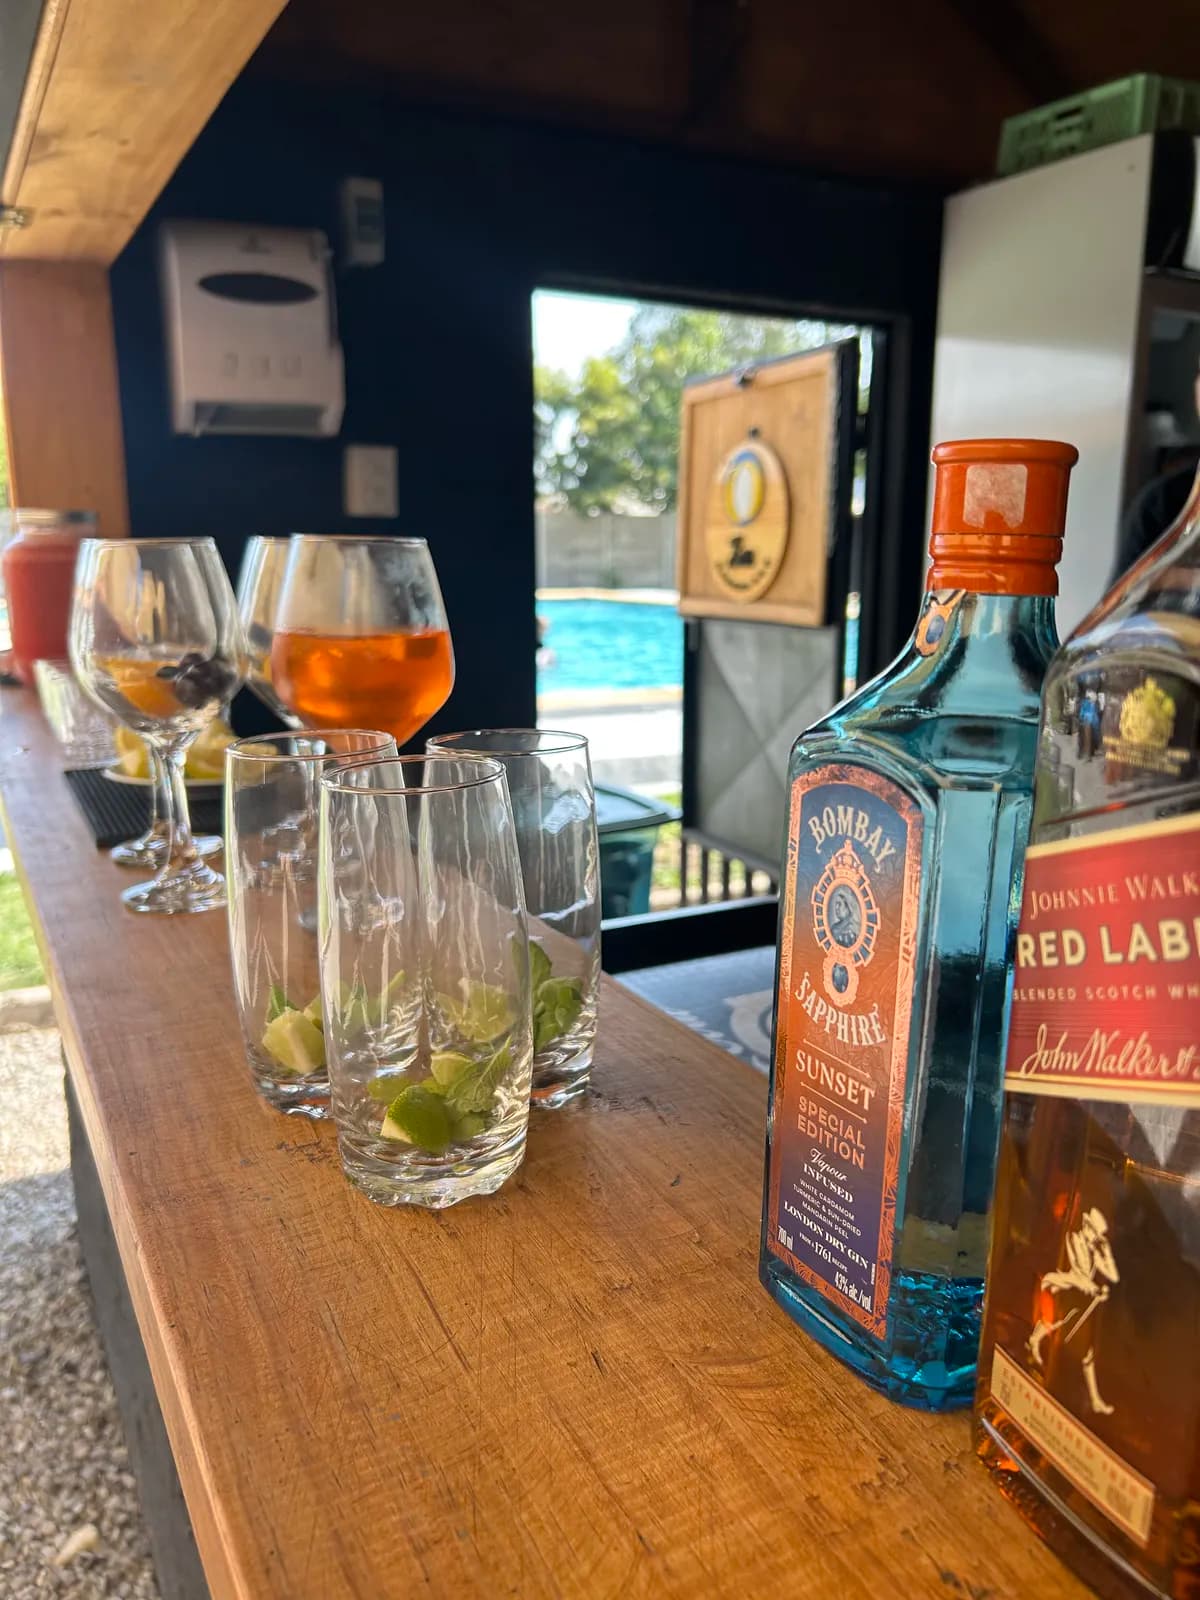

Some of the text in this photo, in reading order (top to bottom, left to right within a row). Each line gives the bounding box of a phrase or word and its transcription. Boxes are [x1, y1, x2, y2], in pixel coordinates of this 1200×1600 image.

[808, 805, 896, 873] BOMBAY
[1030, 882, 1119, 920] JOHNNIE
[1017, 917, 1200, 969] RED LAB
[795, 971, 887, 1046] SAPPHIRE
[1012, 986, 1077, 1001] BLENDED
[1085, 983, 1157, 1000] SCOTCH
[1020, 1023, 1082, 1078] John
[1080, 1027, 1174, 1078] Walker
[796, 1049, 876, 1111] SUNSET
[798, 1113, 865, 1170] EDITION
[799, 1096, 866, 1150] SPECIAL
[803, 1163, 854, 1203] INFUSED
[810, 1148, 848, 1181] Vapour
[793, 1183, 821, 1208] TURMERIC
[827, 1208, 862, 1237] SUN-DRIED
[800, 1178, 855, 1222] WHITE CARDAMOM
[801, 1200, 849, 1239] MANDARIN PEEL
[784, 1200, 869, 1269] LONDON DRY GIN
[815, 1241, 832, 1263] 1761
